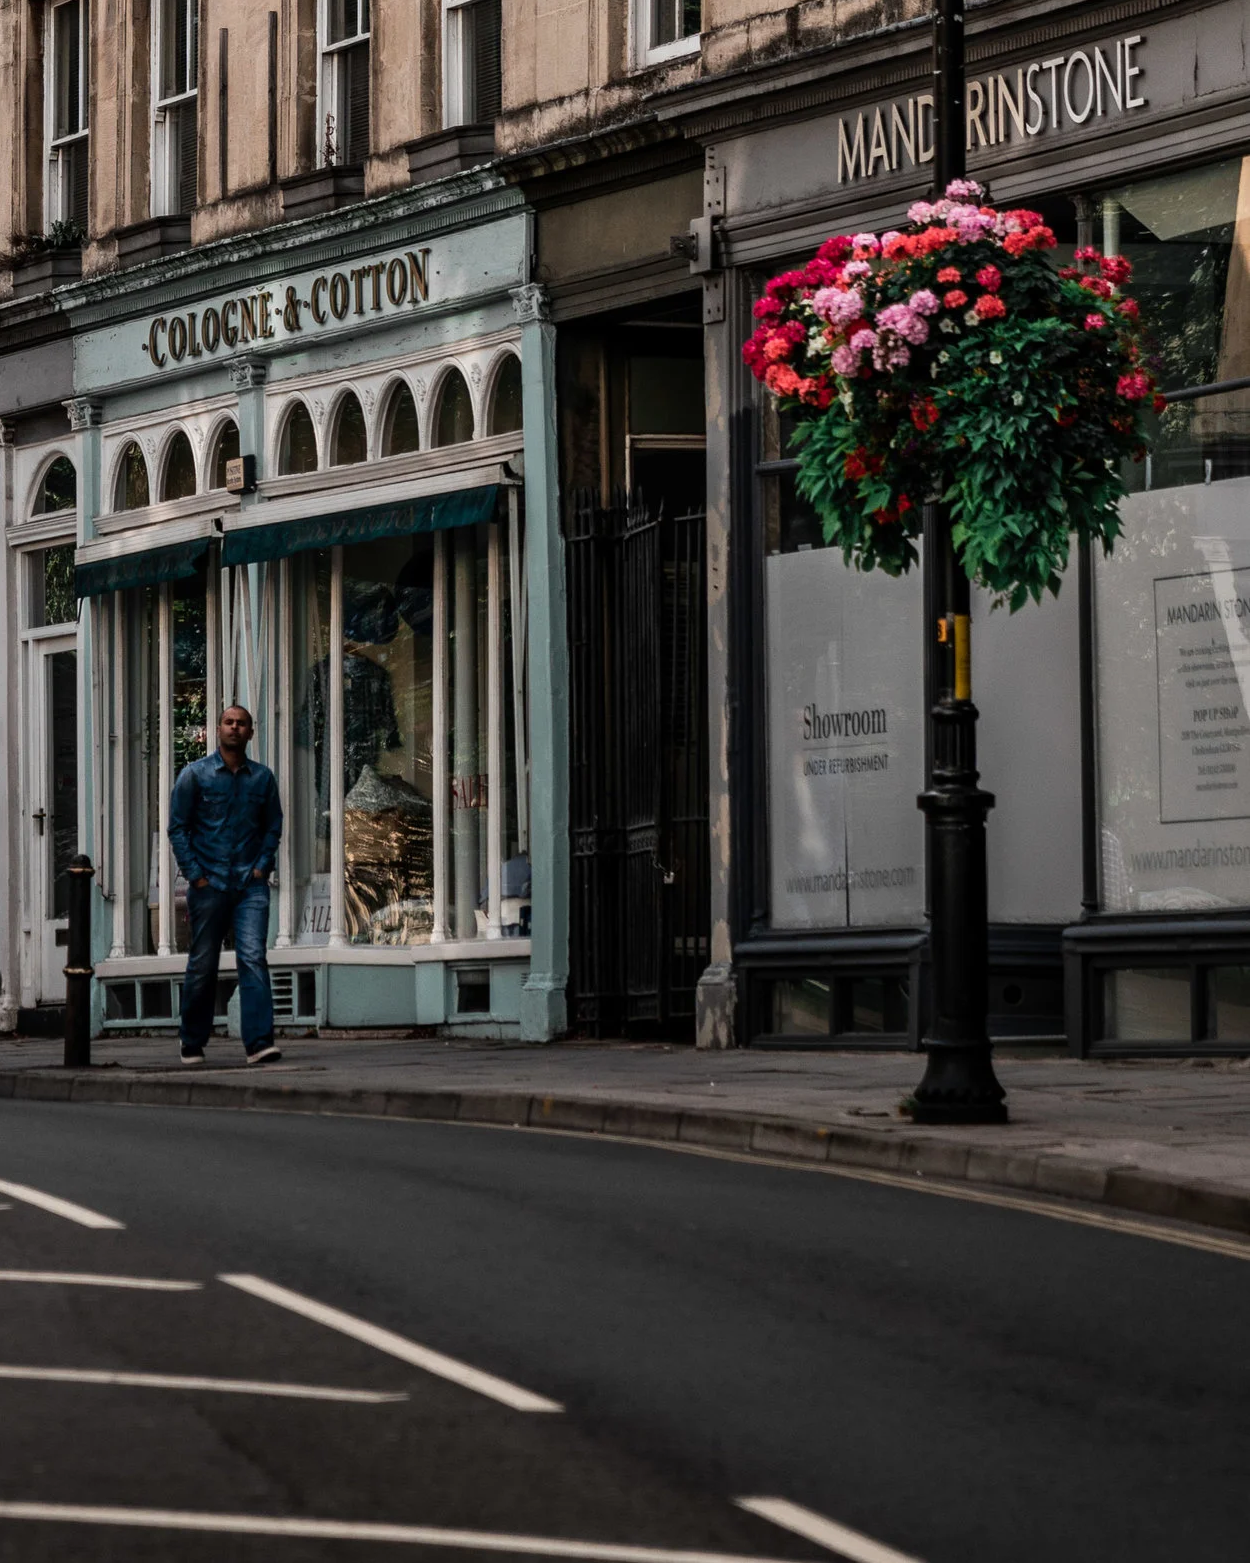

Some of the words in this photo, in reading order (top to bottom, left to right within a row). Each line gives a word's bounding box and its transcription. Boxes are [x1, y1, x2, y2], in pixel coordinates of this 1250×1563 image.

[837, 35, 1145, 183] MANDRINSTONE
[149, 291, 275, 367] COLOGNE
[283, 285, 302, 332] &
[311, 247, 431, 325] COTTON
[803, 703, 887, 740] Showroom
[803, 757, 827, 776] UNDER
[829, 754, 888, 774] REFURBISHMENT
[786, 866, 915, 893] www.mandanstone.com
